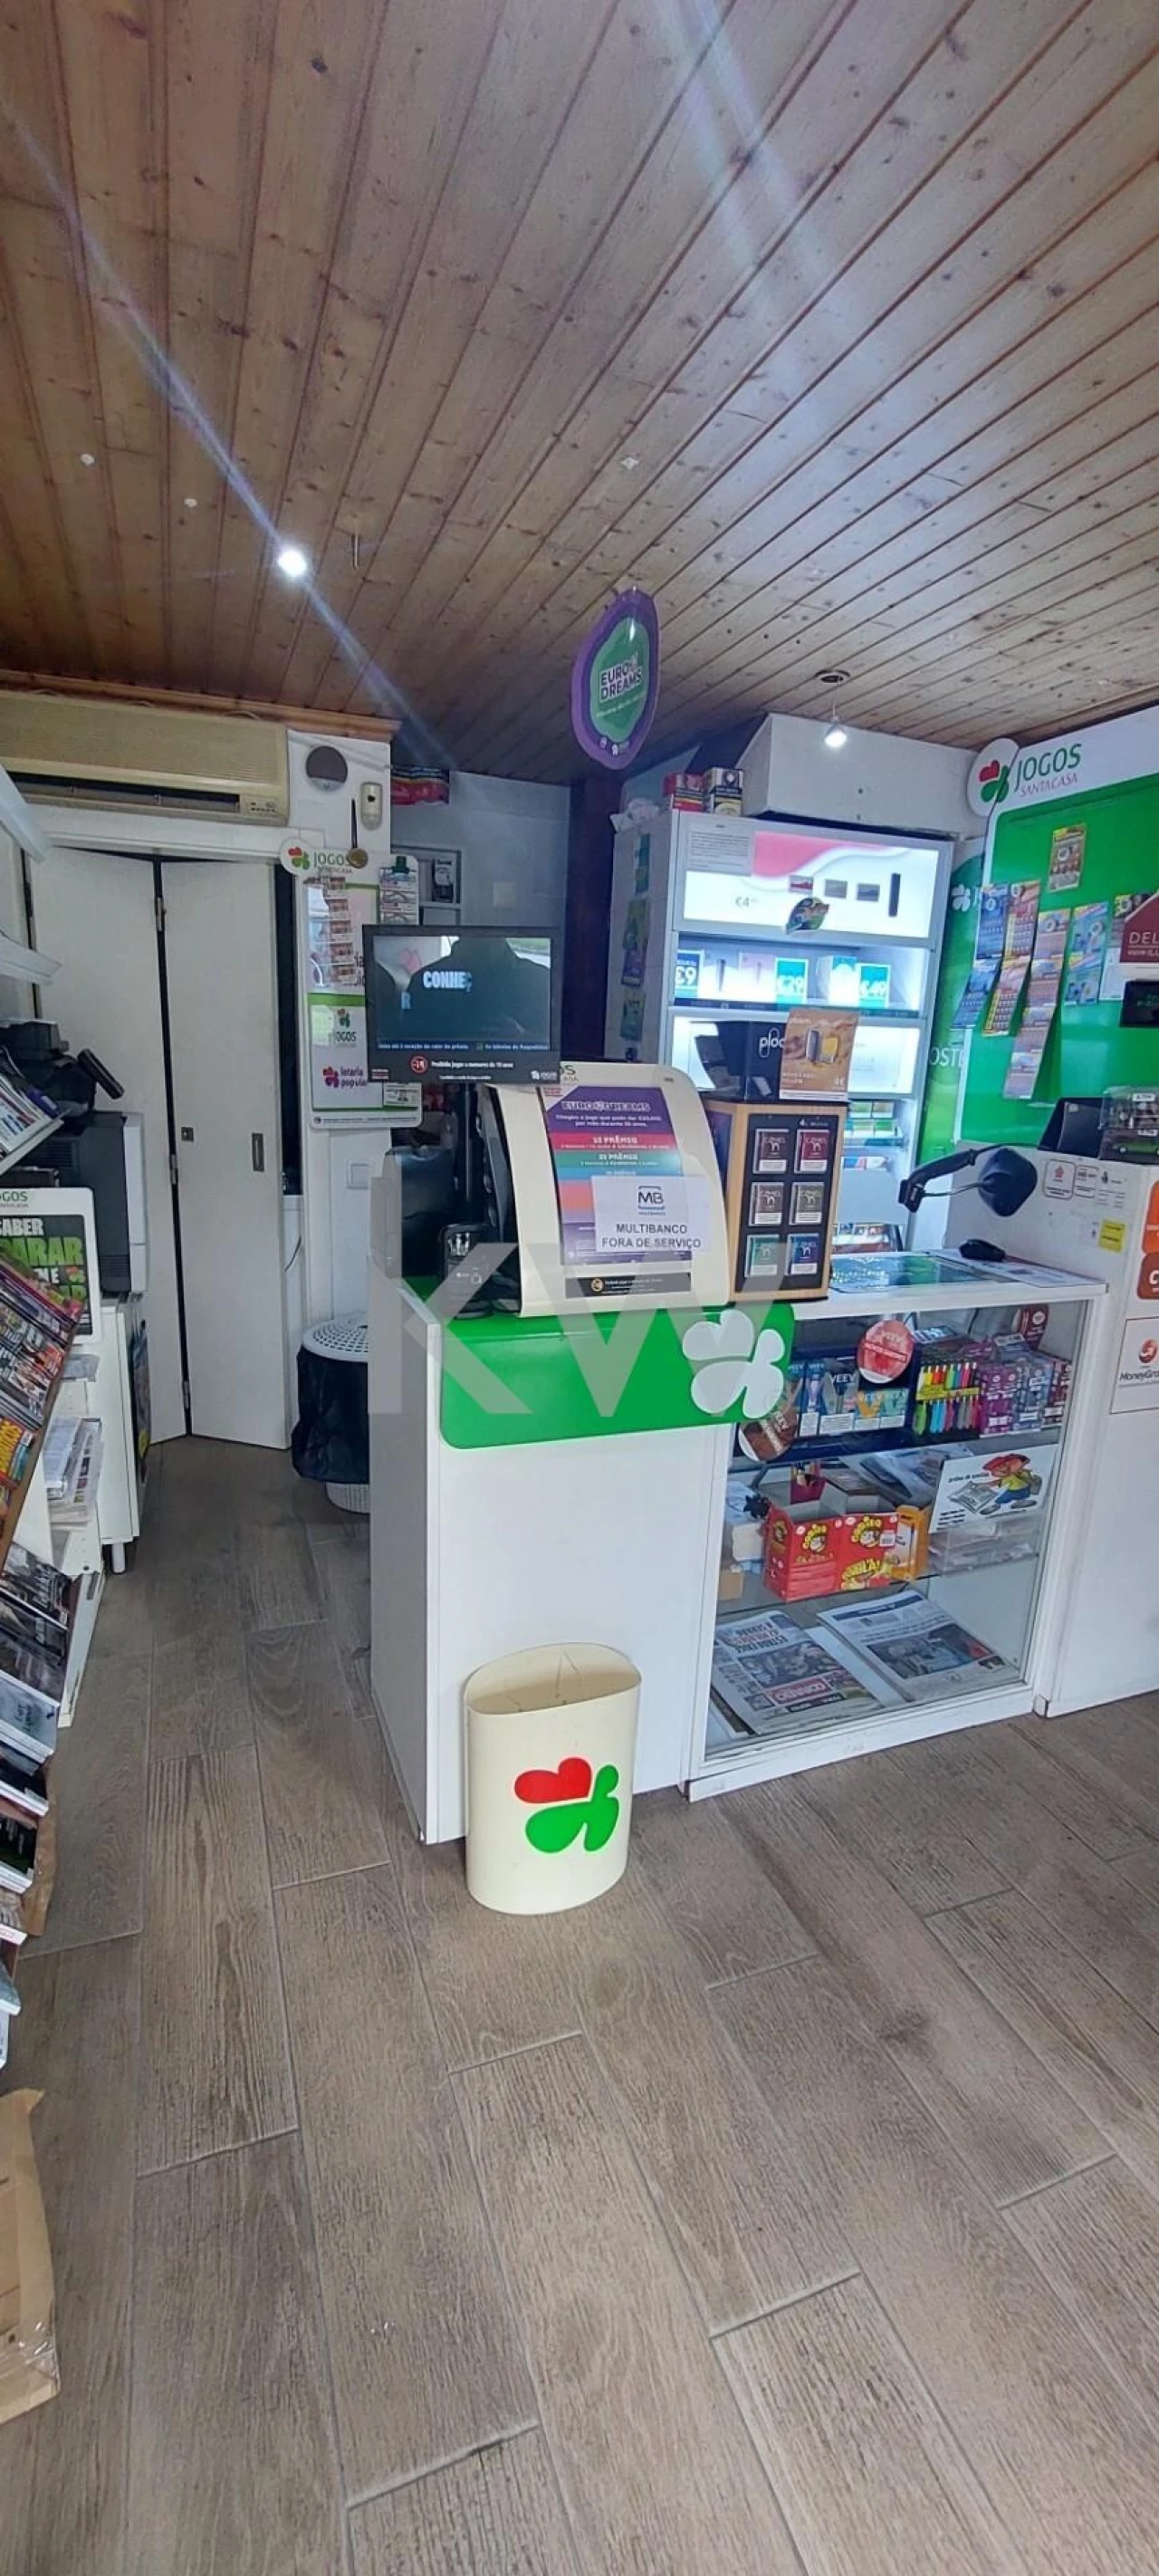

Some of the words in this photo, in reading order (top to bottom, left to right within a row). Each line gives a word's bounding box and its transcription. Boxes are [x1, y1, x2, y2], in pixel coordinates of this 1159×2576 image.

[1014, 744, 1081, 793] JOGOS
[0, 1191, 28, 1203] GOS
[638, 1191, 665, 1205] MB
[616, 1223, 687, 1234] MULTIBANCO
[601, 1237, 634, 1247] FORA
[636, 1237, 650, 1247] DE
[654, 1237, 701, 1250] SERVIÇO
[830, 1373, 855, 1384] VEEV
